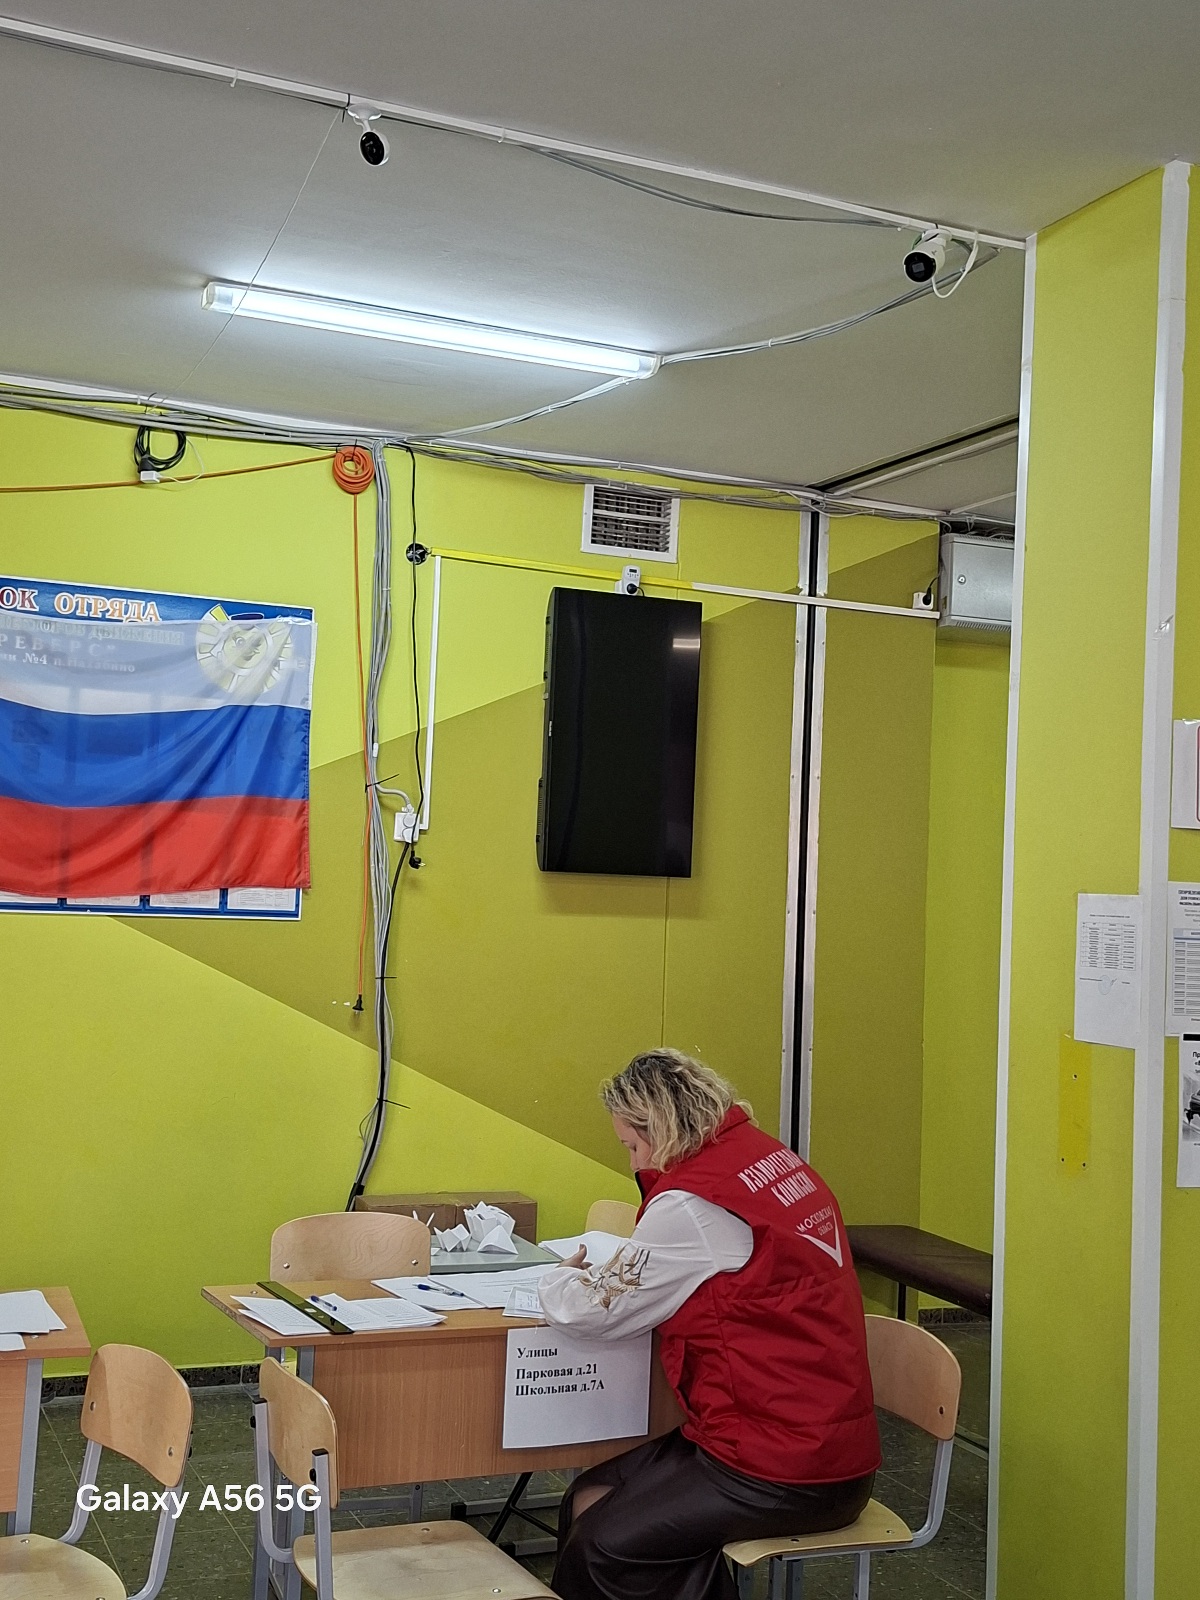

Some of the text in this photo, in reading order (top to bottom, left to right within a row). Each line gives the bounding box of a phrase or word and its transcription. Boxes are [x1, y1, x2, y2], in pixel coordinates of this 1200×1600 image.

[54, 592, 162, 623] ОТРЯДА
[22, 651, 48, 665] №4
[517, 1347, 558, 1359] Улицы
[516, 1363, 597, 1381] Парковая д.21
[515, 1379, 605, 1396] Школьная д.7А
